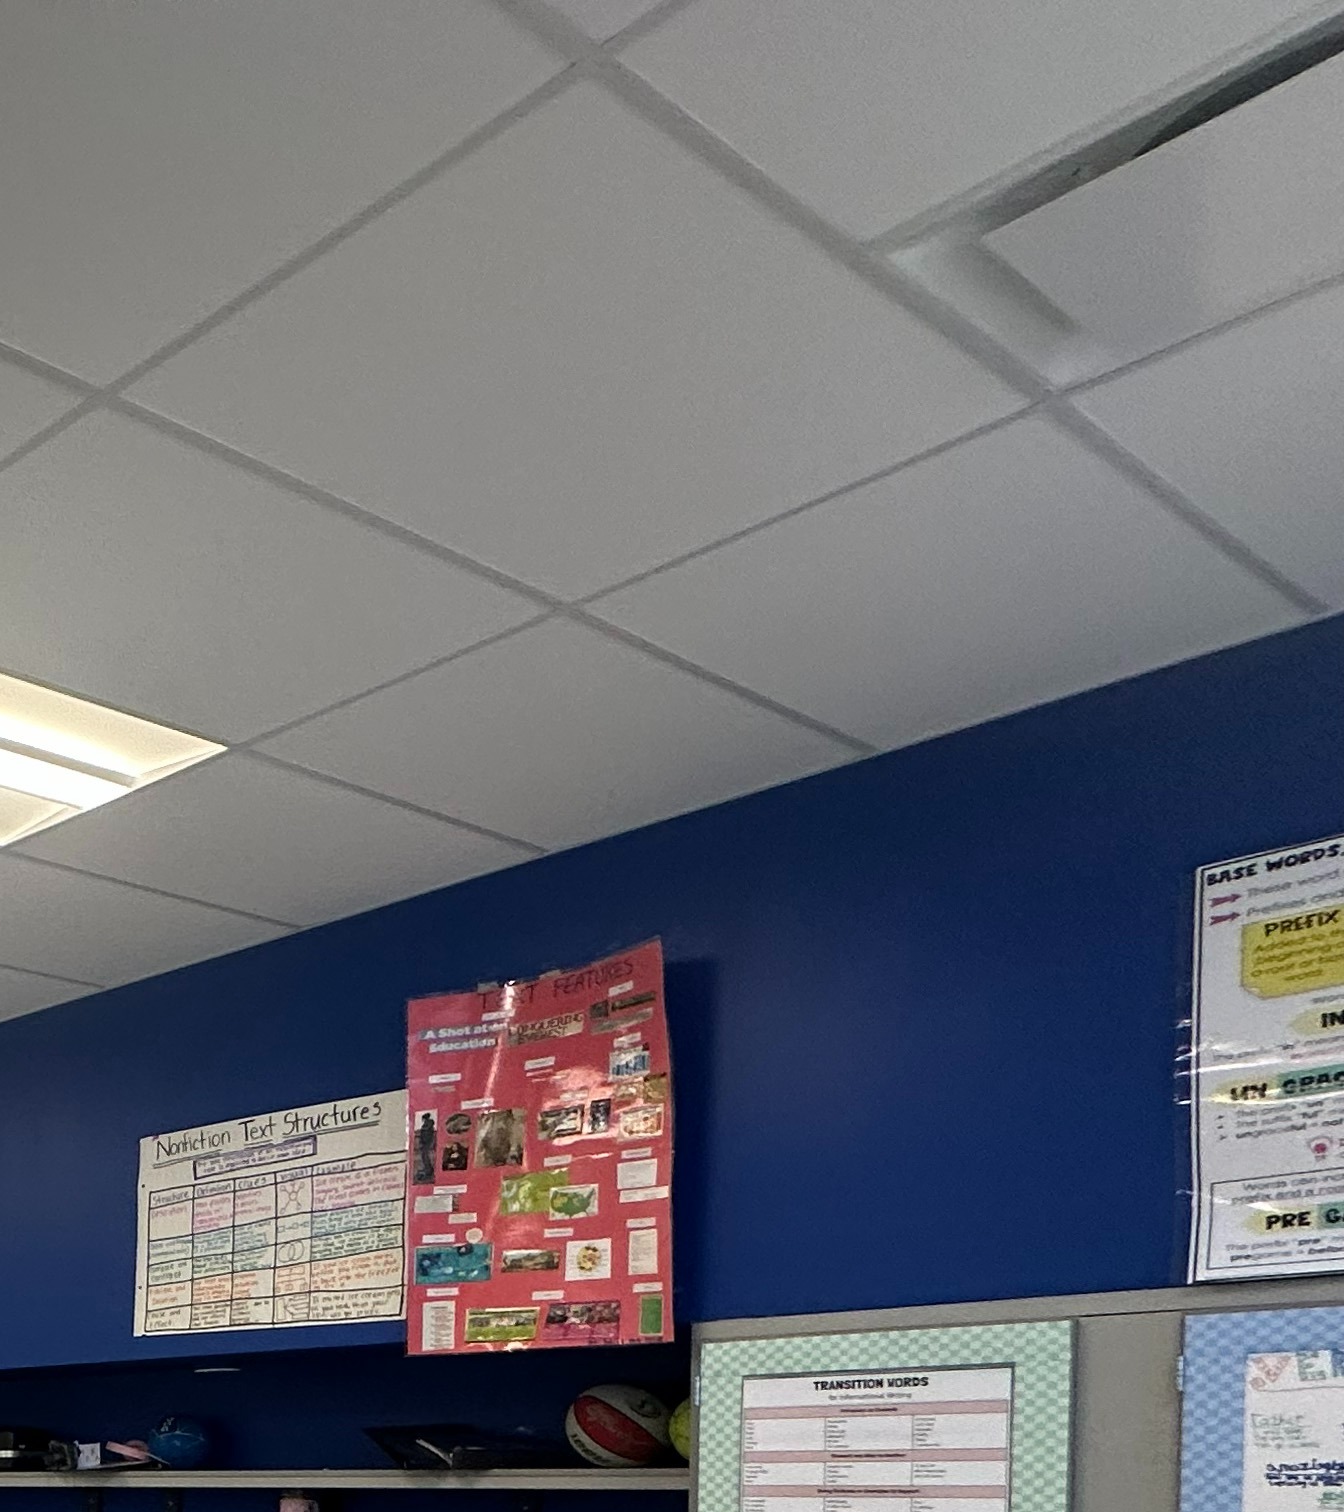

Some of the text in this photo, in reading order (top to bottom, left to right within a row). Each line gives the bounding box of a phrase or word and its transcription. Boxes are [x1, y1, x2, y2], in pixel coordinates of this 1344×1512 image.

[1206, 863, 1259, 887] BASE
[1264, 908, 1341, 938] PREFIX
[553, 958, 634, 998] FEATURES
[424, 1024, 488, 1040] A Shot at
[428, 1037, 497, 1054] Education
[156, 1128, 231, 1160] Nonfiction
[239, 1118, 277, 1141] Text
[283, 1100, 382, 1136] Structures
[1265, 1211, 1311, 1231] PRE
[813, 1376, 930, 1391] TRANSITION WORDS
